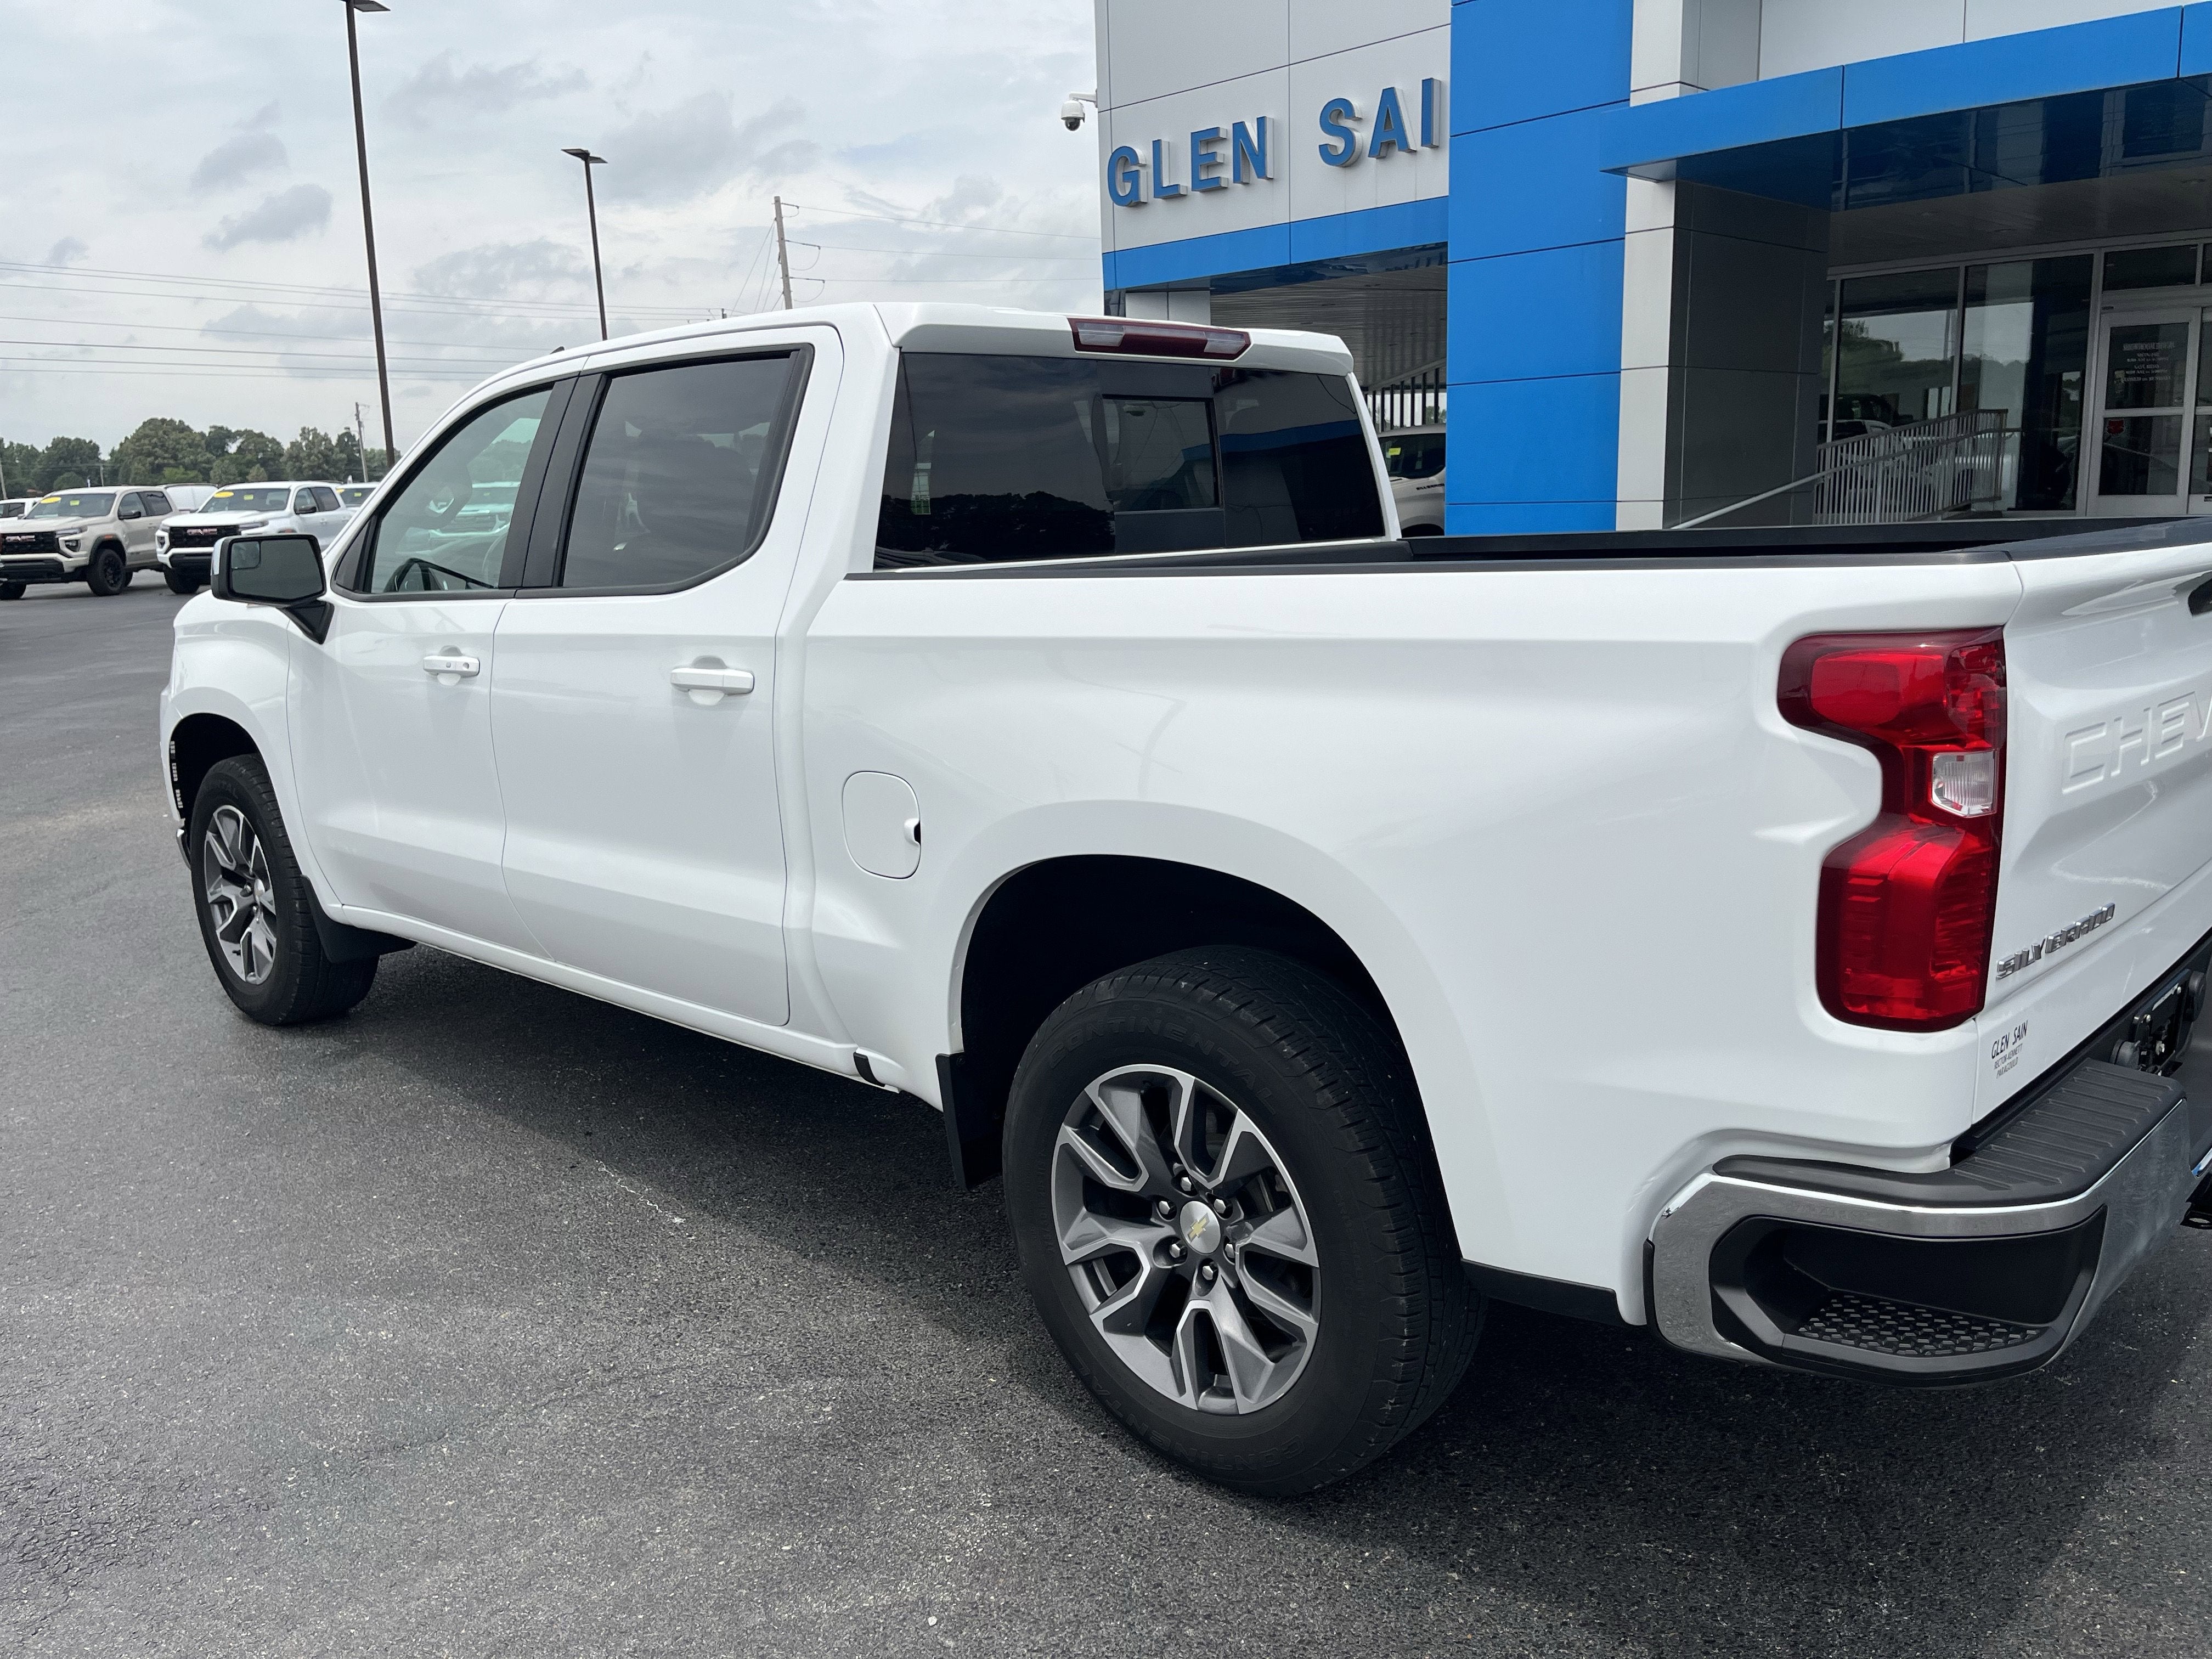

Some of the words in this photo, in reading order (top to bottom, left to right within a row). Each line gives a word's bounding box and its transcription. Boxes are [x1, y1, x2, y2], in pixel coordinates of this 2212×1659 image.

[1108, 116, 1274, 207] GLEN
[1996, 902, 2115, 980] SILVERADO
[1048, 1015, 1277, 1116] CONTINENTAL
[1991, 1032, 2010, 1059] GLEN
[2012, 1020, 2028, 1045] SAIN
[1075, 1352, 1306, 1471] CONTINENTAL
